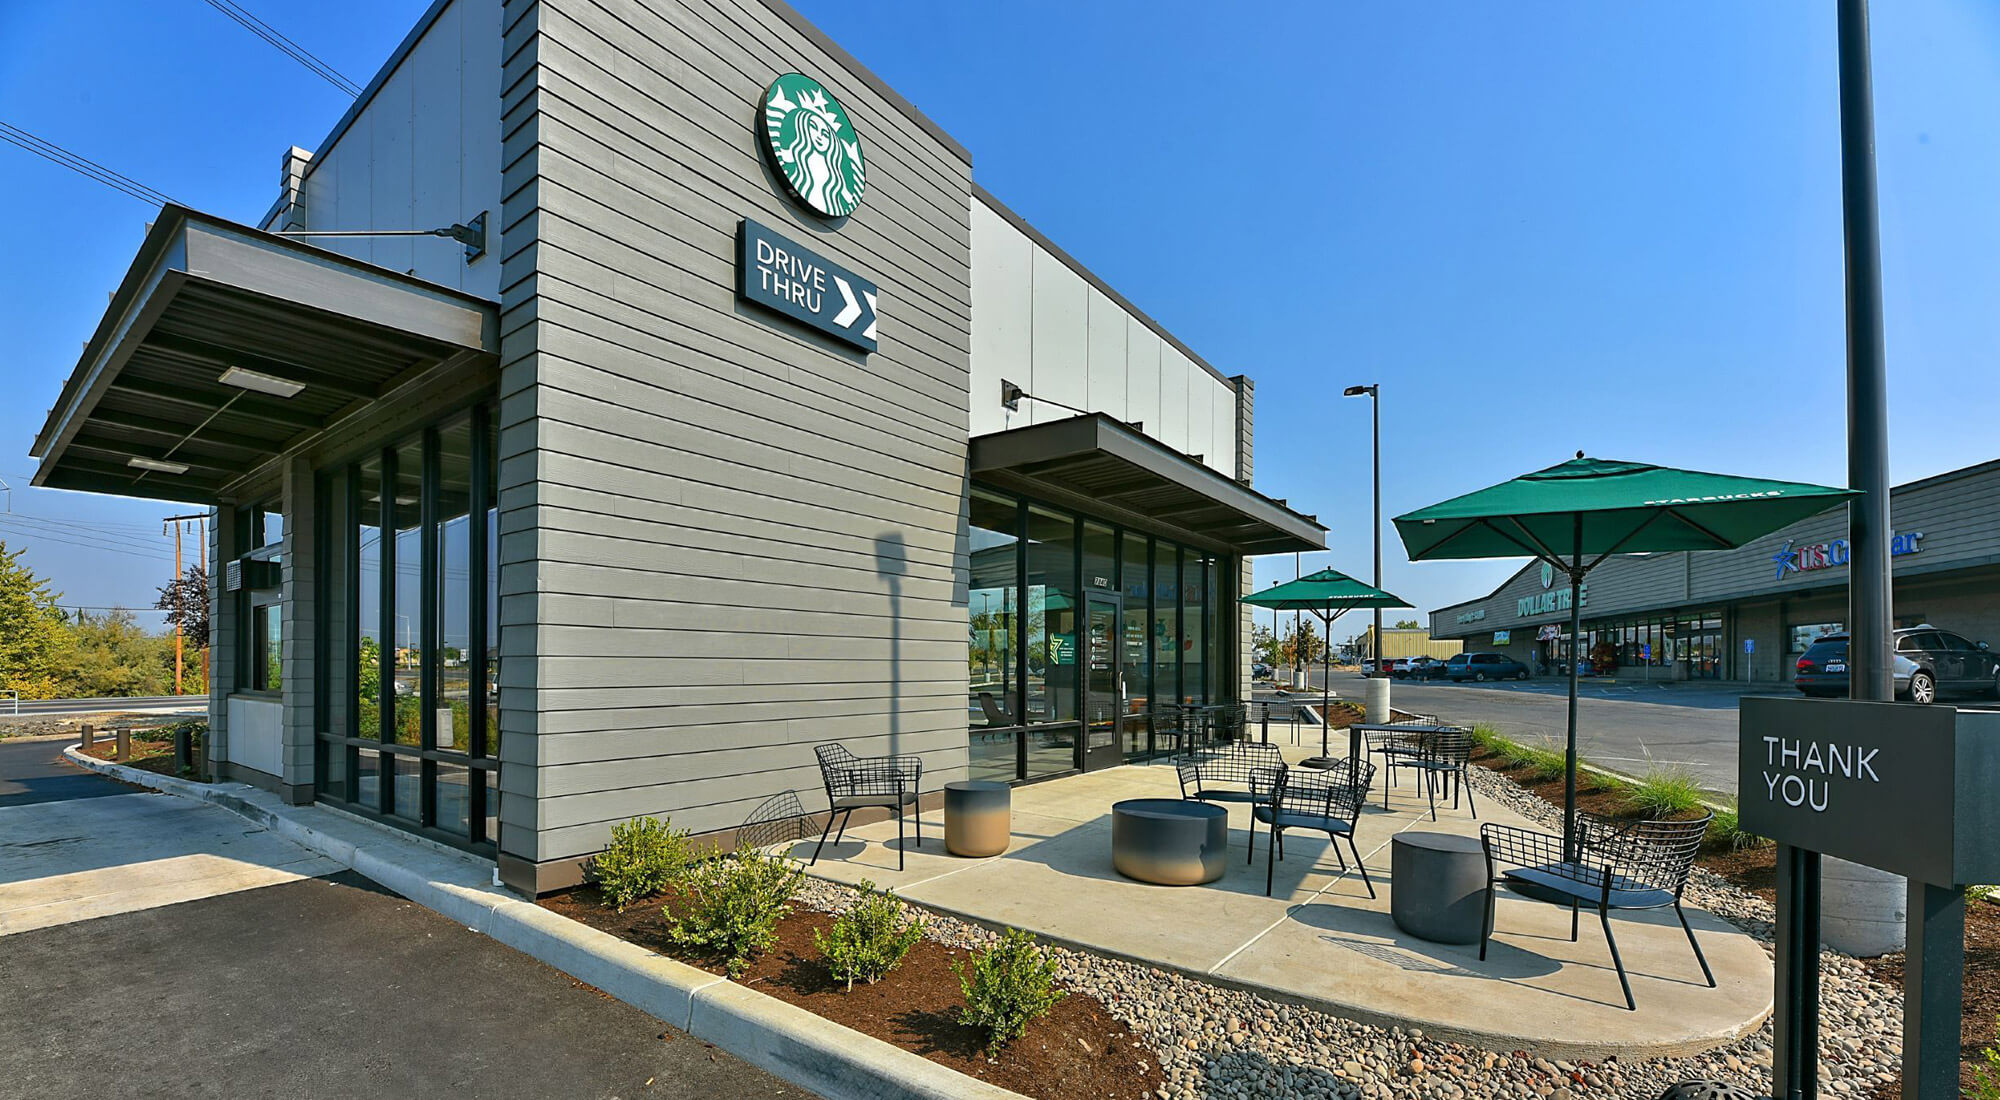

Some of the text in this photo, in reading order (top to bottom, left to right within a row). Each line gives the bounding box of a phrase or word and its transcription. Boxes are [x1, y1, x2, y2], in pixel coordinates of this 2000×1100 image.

[757, 238, 826, 293] DRIVE
[757, 265, 821, 314] THRU
[1517, 591, 1556, 617] DOLLAR
[1556, 583, 1589, 611] TRE
[1763, 736, 1880, 783] THANK
[1763, 770, 1829, 812] YOU
